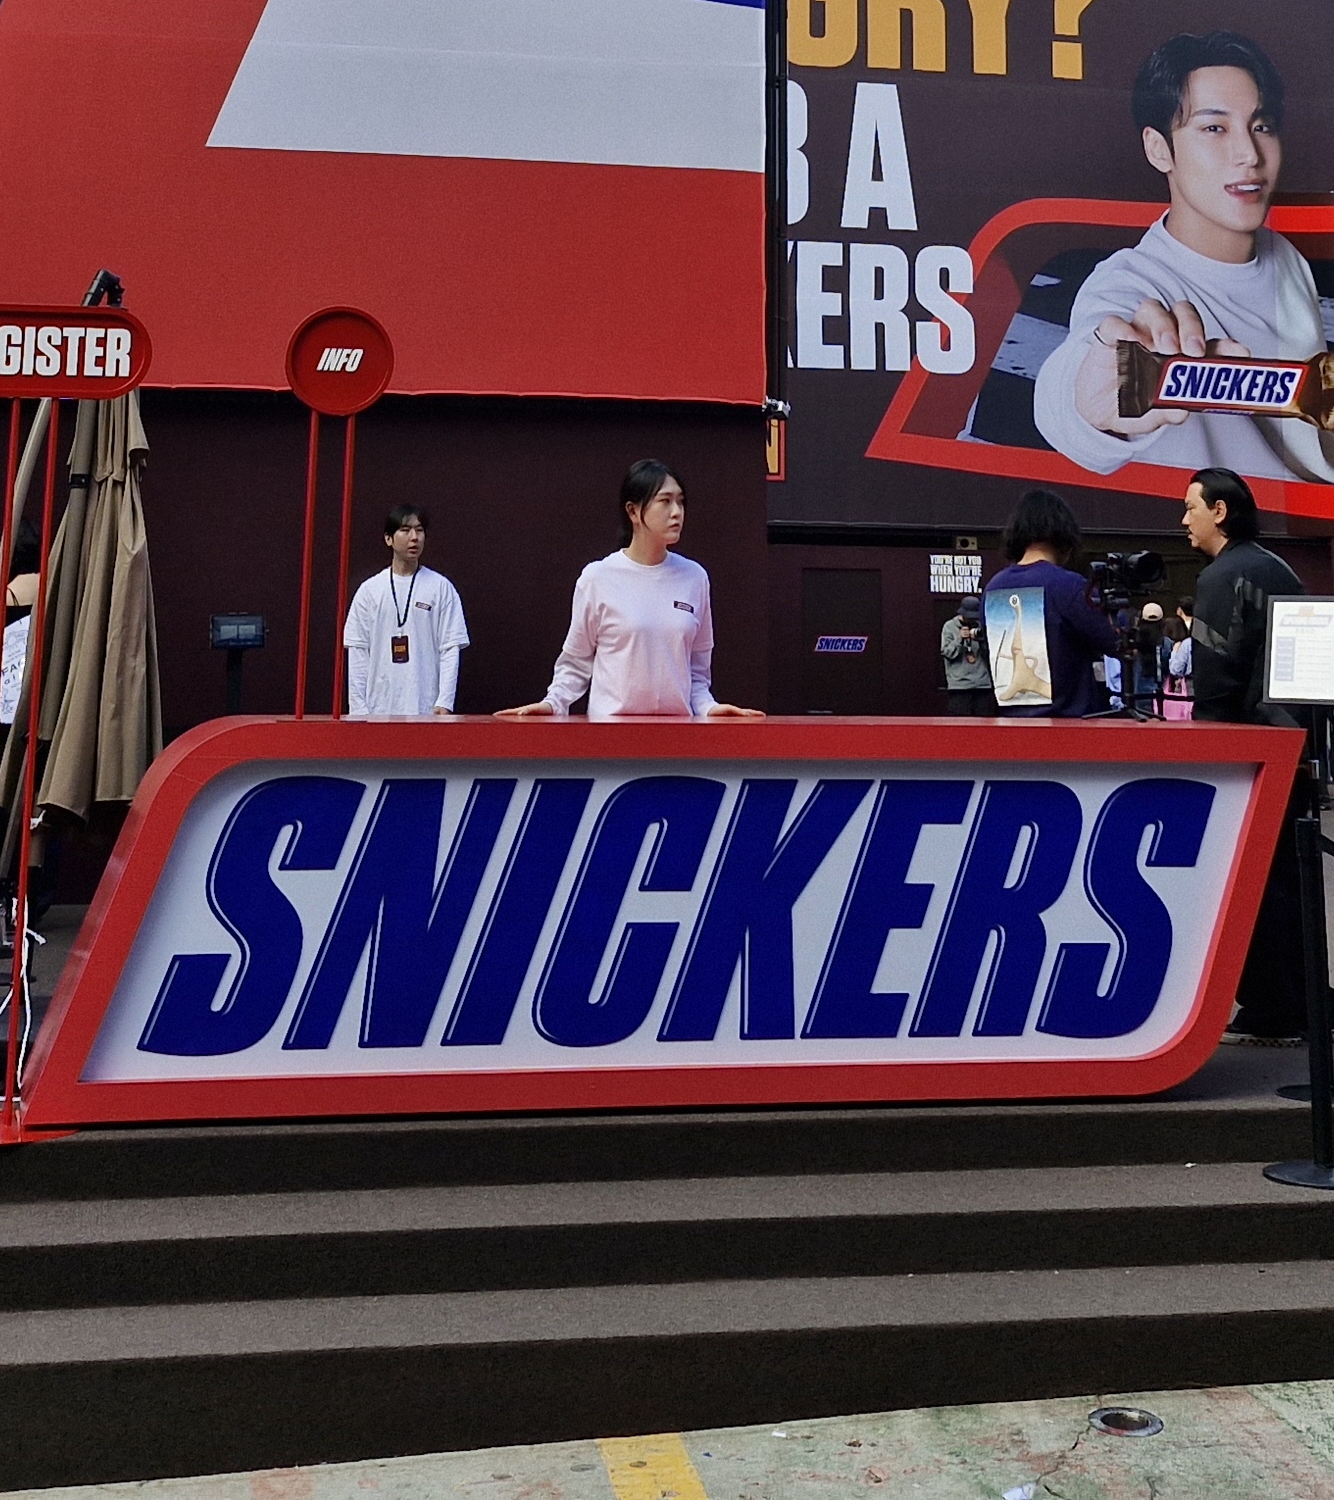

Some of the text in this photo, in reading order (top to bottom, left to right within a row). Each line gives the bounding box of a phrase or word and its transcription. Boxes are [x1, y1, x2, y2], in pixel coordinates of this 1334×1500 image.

[840, 81, 918, 231] A
[787, 239, 976, 375] ERS
[316, 347, 364, 373] INFO
[1165, 364, 1297, 404] SNICKERS
[930, 564, 982, 577] WHEN YOU'RE
[930, 575, 983, 593] HUNGRY.
[817, 638, 865, 651] SNICKERS
[135, 775, 1218, 1057] SNICKERS
